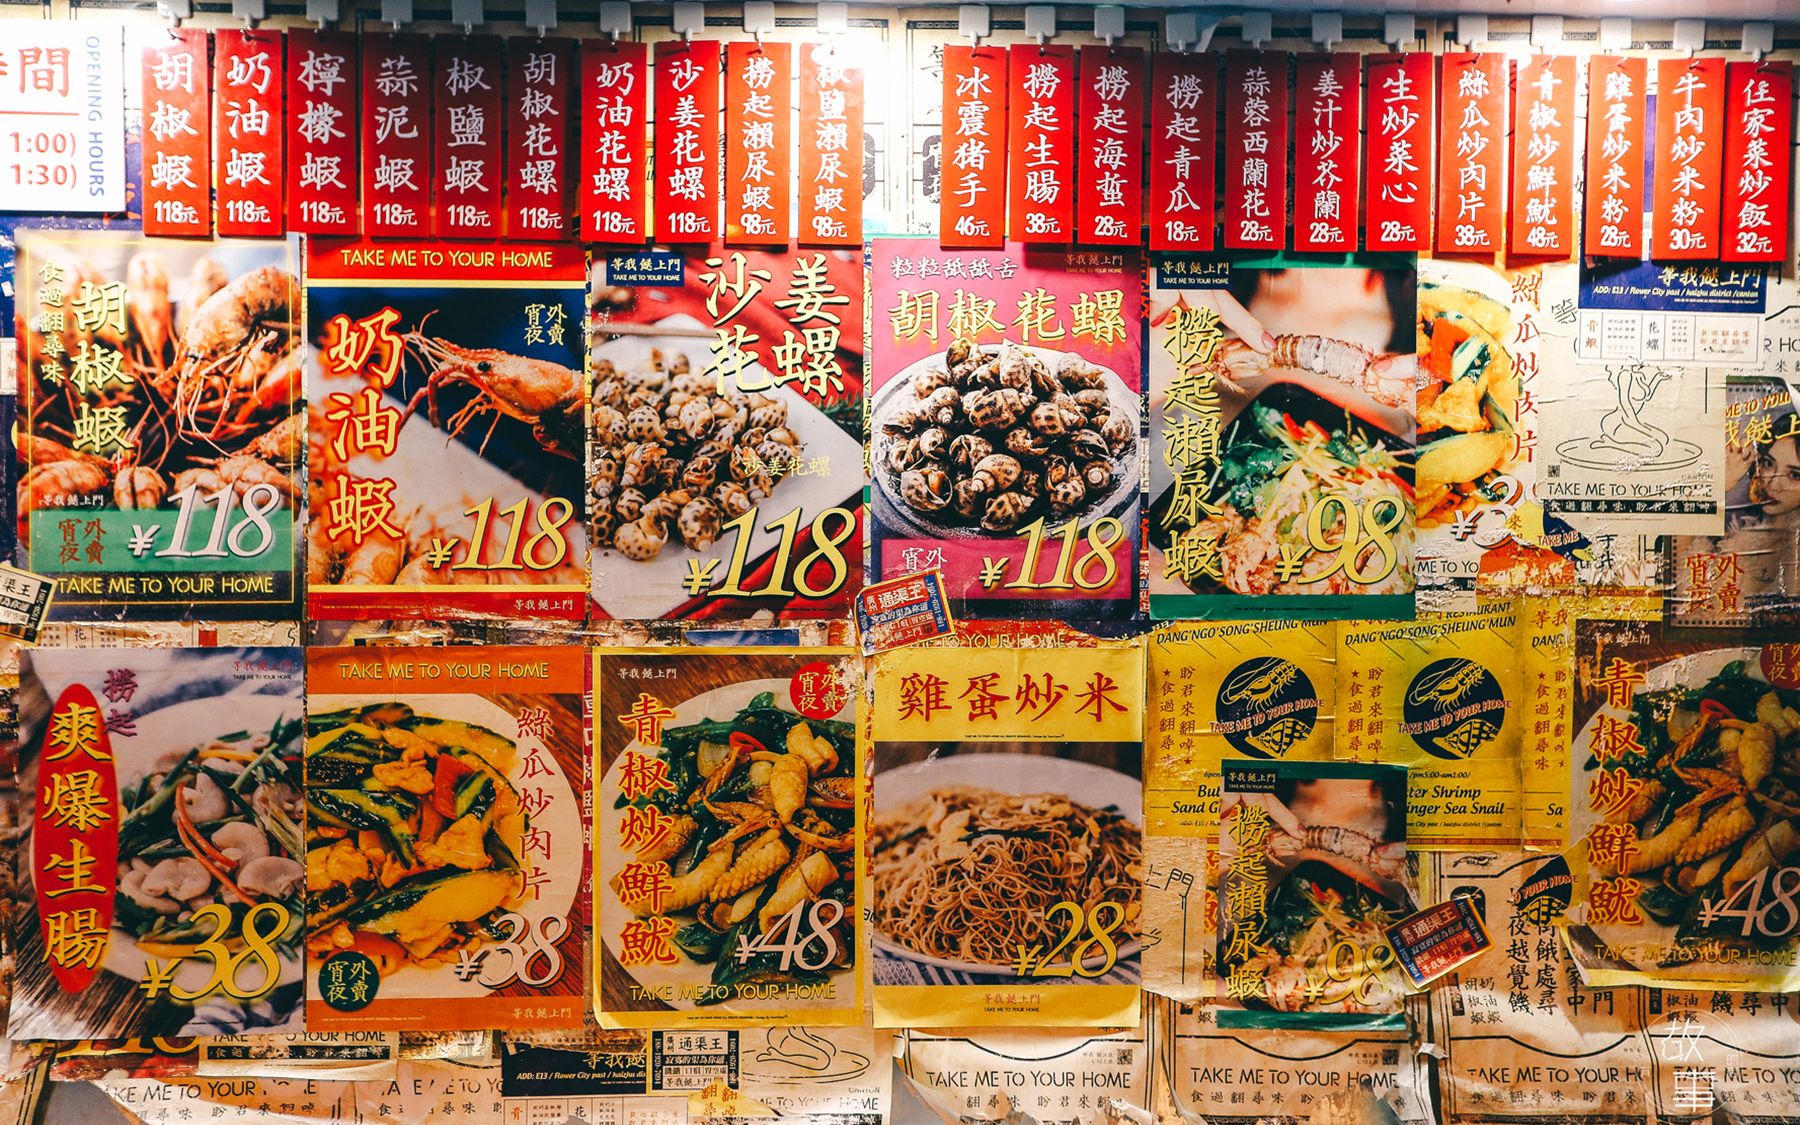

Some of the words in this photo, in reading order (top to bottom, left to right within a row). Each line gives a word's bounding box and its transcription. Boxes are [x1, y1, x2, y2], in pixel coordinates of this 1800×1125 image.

[85, 36, 103, 122] OPENING
[148, 48, 201, 190] 胡椒蝦
[222, 52, 271, 187] 奶油蝦
[298, 50, 346, 190] 檸檬蝦
[374, 56, 418, 192] 蒜泥蝦
[445, 58, 491, 194] 椒鹽蝦
[520, 54, 559, 194] 胡椒花螺
[669, 59, 705, 201] 沙姜花螺
[593, 62, 634, 201] 奶油花螺
[1023, 64, 1060, 204] 撈起生腸
[1382, 69, 1419, 203] 生炒菜心
[1165, 75, 1203, 213] 撈起青瓜
[1312, 69, 1343, 220] 姜汁炒芥蘭
[1458, 68, 1490, 221] 絲瓜炒肉片
[1602, 72, 1633, 223] 雞蛋炒米粉
[1671, 74, 1706, 225] 牛肉炒米粉
[88, 130, 105, 197] HOURS
[154, 200, 199, 223] 118元
[226, 200, 270, 222] 118元
[300, 201, 345, 223] 118元
[374, 204, 417, 225] 118元
[448, 205, 491, 226] 118元
[520, 207, 563, 228] 118元
[593, 211, 635, 234] 118元
[669, 212, 710, 233] 118元
[1026, 213, 1060, 233] 38元
[741, 214, 776, 234] 98元
[812, 216, 847, 237] 98元
[955, 216, 990, 236] 46元
[1095, 216, 1127, 237] 28元
[1165, 221, 1199, 241] 18元
[1241, 221, 1273, 241] 28元
[1310, 222, 1344, 242] 28元
[1381, 221, 1416, 241] 28元
[1455, 225, 1490, 246] 38元
[1600, 225, 1631, 247] 28元
[1527, 227, 1559, 248] 48元
[1670, 229, 1706, 249] 30元
[1737, 232, 1772, 253] 32元
[341, 249, 385, 267] TAKE
[391, 250, 416, 267] ME
[421, 250, 443, 268] TO
[448, 250, 495, 268] YOUR
[502, 251, 553, 268] HOME
[887, 287, 1128, 345] 胡椒花螺
[71, 280, 135, 452] 胡椒蝦
[328, 308, 404, 545] 奶油蝦
[1547, 482, 1580, 496] TAKE
[1585, 483, 1605, 496] ME
[1610, 483, 1626, 497] TO
[127, 482, 280, 558] ¥118
[427, 496, 574, 570] ¥118
[1273, 495, 1406, 584] ¥98
[683, 506, 856, 598] ¥118
[979, 516, 1124, 590] ¥118
[57, 577, 101, 595] TAKE
[109, 577, 134, 595] ME
[141, 577, 163, 595] TO
[168, 577, 213, 595] YOUR
[222, 577, 273, 595] HOME
[339, 663, 382, 679] TAKE
[388, 663, 414, 679] ME
[419, 663, 441, 679] TO
[445, 663, 491, 679] YOUR
[498, 663, 549, 679] HOME
[102, 668, 139, 737] 撈起
[897, 672, 1129, 722] 雞蛋炒米
[515, 707, 555, 901] 絲瓜炒肉片
[1432, 785, 1481, 801] Shrimp
[1171, 801, 1205, 813] Sand
[1443, 802, 1467, 814] Sea
[1471, 802, 1504, 815] Snail
[41, 702, 112, 970] 爽爆生腸
[617, 693, 679, 965] 青椒炒鮮魷
[734, 898, 845, 972] ¥48
[1011, 901, 1125, 977] ¥28
[139, 902, 290, 1000] ¥38
[454, 913, 572, 990] ¥38
[1594, 943, 1635, 961] TAKE
[1641, 945, 1666, 961] ME
[1670, 945, 1693, 962] TO
[1695, 946, 1742, 964] YOUR
[1747, 949, 1798, 967] HOME
[629, 985, 672, 1002] TAKE
[678, 985, 703, 1002] ME
[707, 984, 728, 1001] TO
[733, 984, 779, 1000] YOUR
[785, 984, 836, 1000] HOME
[678, 1036, 723, 1051] 通渠王
[926, 1071, 968, 1087] TAKE
[974, 1071, 999, 1087] ME
[1003, 1071, 1025, 1087] TO
[1030, 1071, 1076, 1088] YOUR
[1082, 1072, 1131, 1089] HOME
[1191, 1068, 1233, 1084] TAKE
[1239, 1068, 1264, 1084] ME
[1268, 1069, 1290, 1085] TO
[1295, 1070, 1340, 1087] YOUR
[1348, 1071, 1399, 1089] HOME
[143, 1085, 171, 1101] ME
[179, 1084, 201, 1099] TO
[208, 1081, 256, 1097] YOUR
